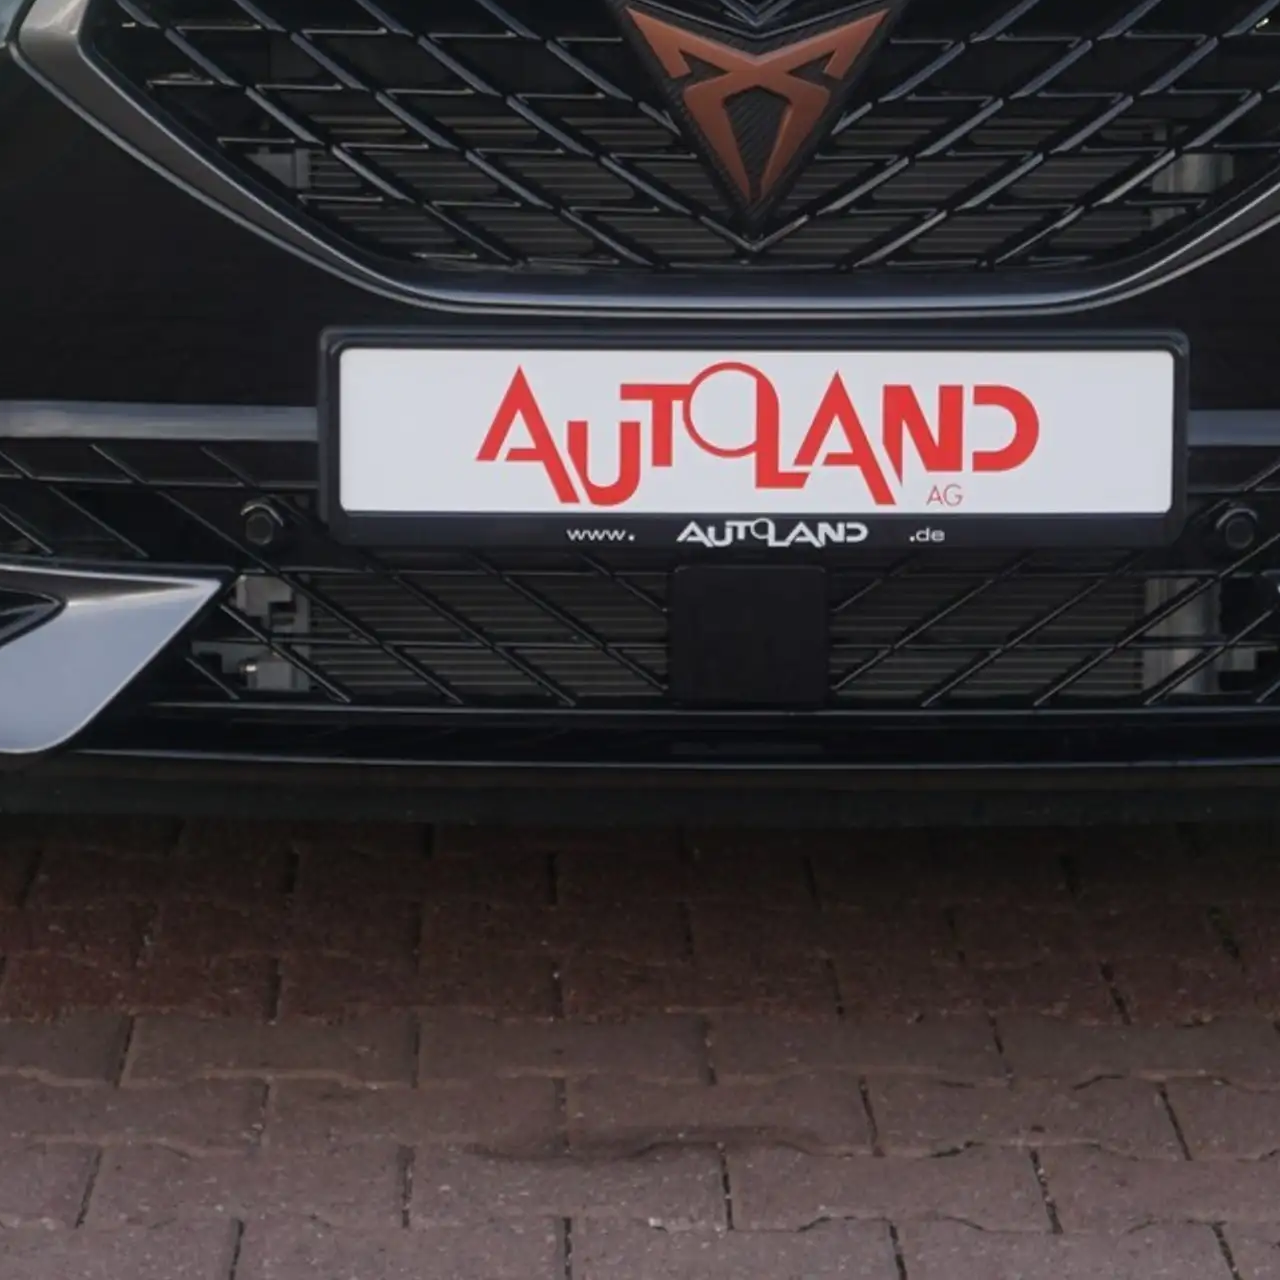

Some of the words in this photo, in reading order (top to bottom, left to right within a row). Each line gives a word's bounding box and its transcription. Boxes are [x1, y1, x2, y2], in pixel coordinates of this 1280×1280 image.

[475, 360, 1041, 507] AUTOLAND
[925, 483, 964, 507] AG
[565, 527, 636, 542] www.
[675, 517, 870, 548] AUTOLAND
[908, 526, 946, 543] .de
